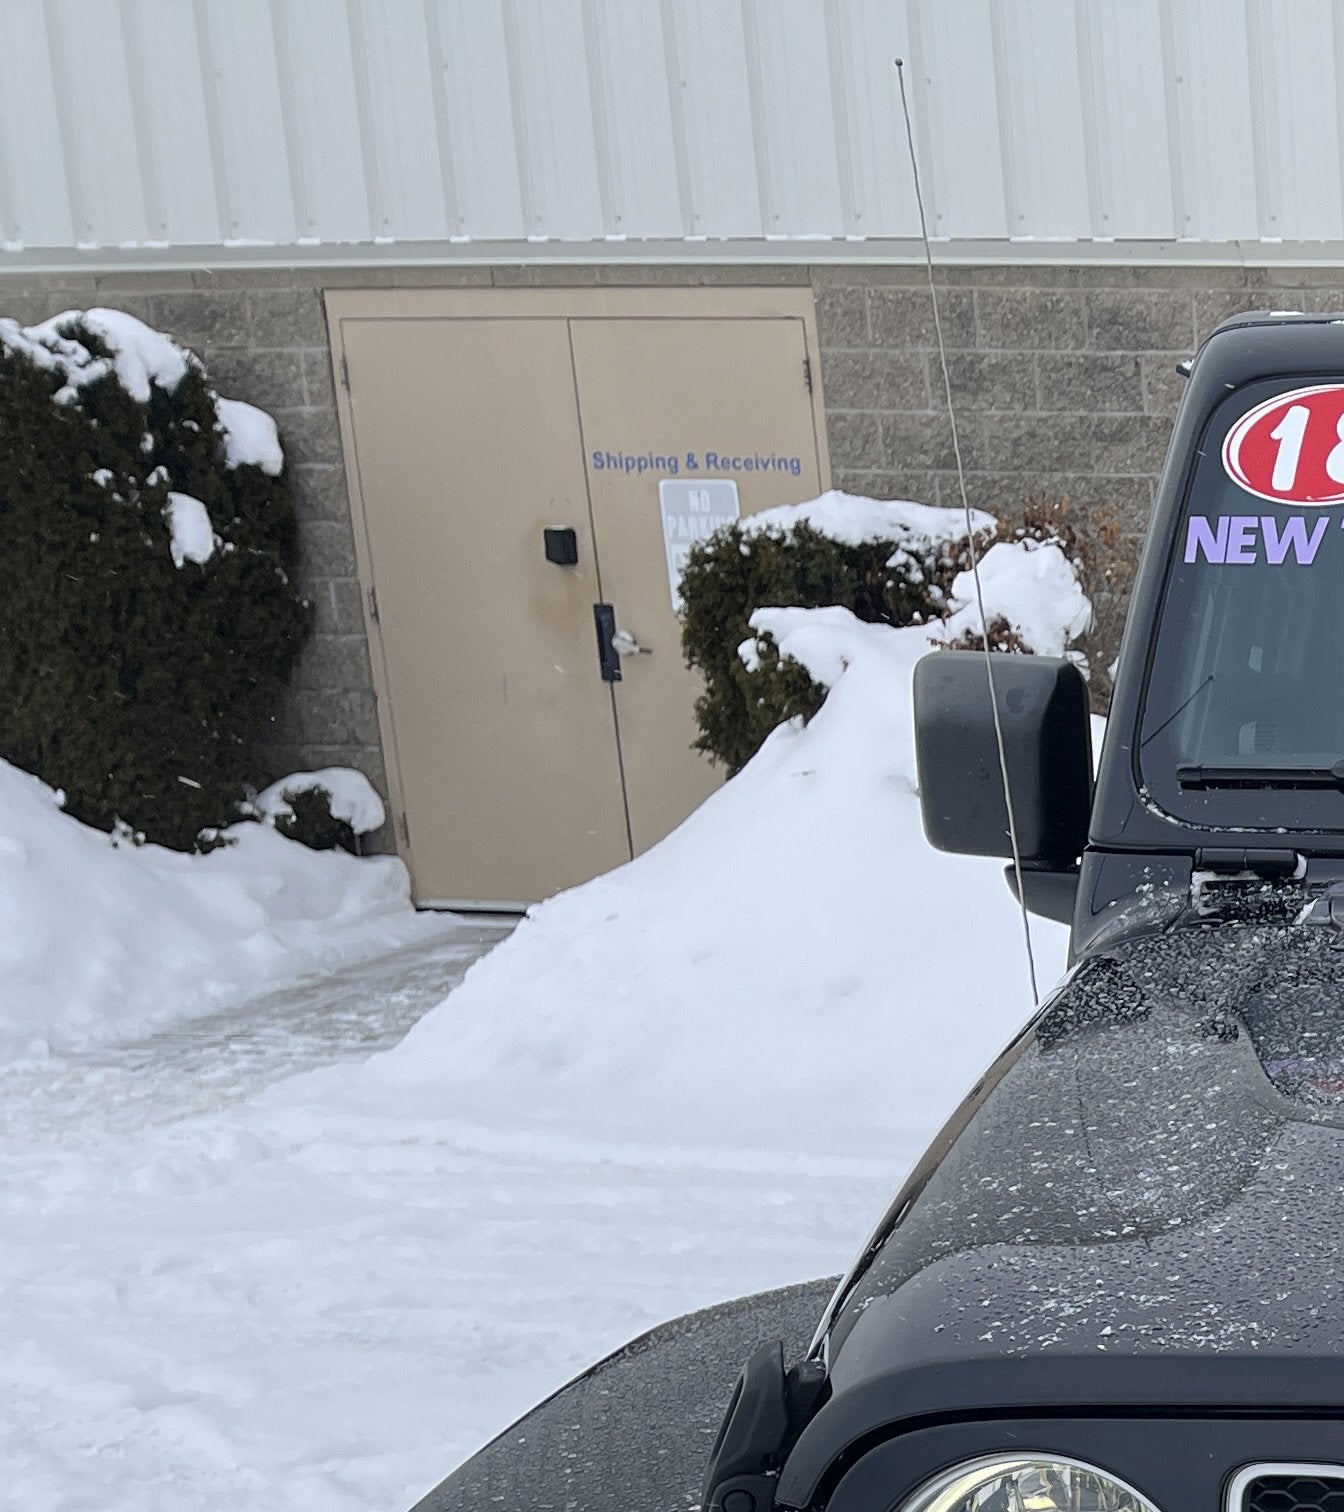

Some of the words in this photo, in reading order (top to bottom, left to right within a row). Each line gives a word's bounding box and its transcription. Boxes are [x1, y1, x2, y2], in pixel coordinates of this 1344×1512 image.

[592, 451, 679, 475] Shipping
[686, 452, 699, 470] &
[705, 452, 802, 476] Receiving
[687, 489, 711, 513] NO
[666, 514, 737, 539] PARKI
[1183, 515, 1330, 565] NEW
